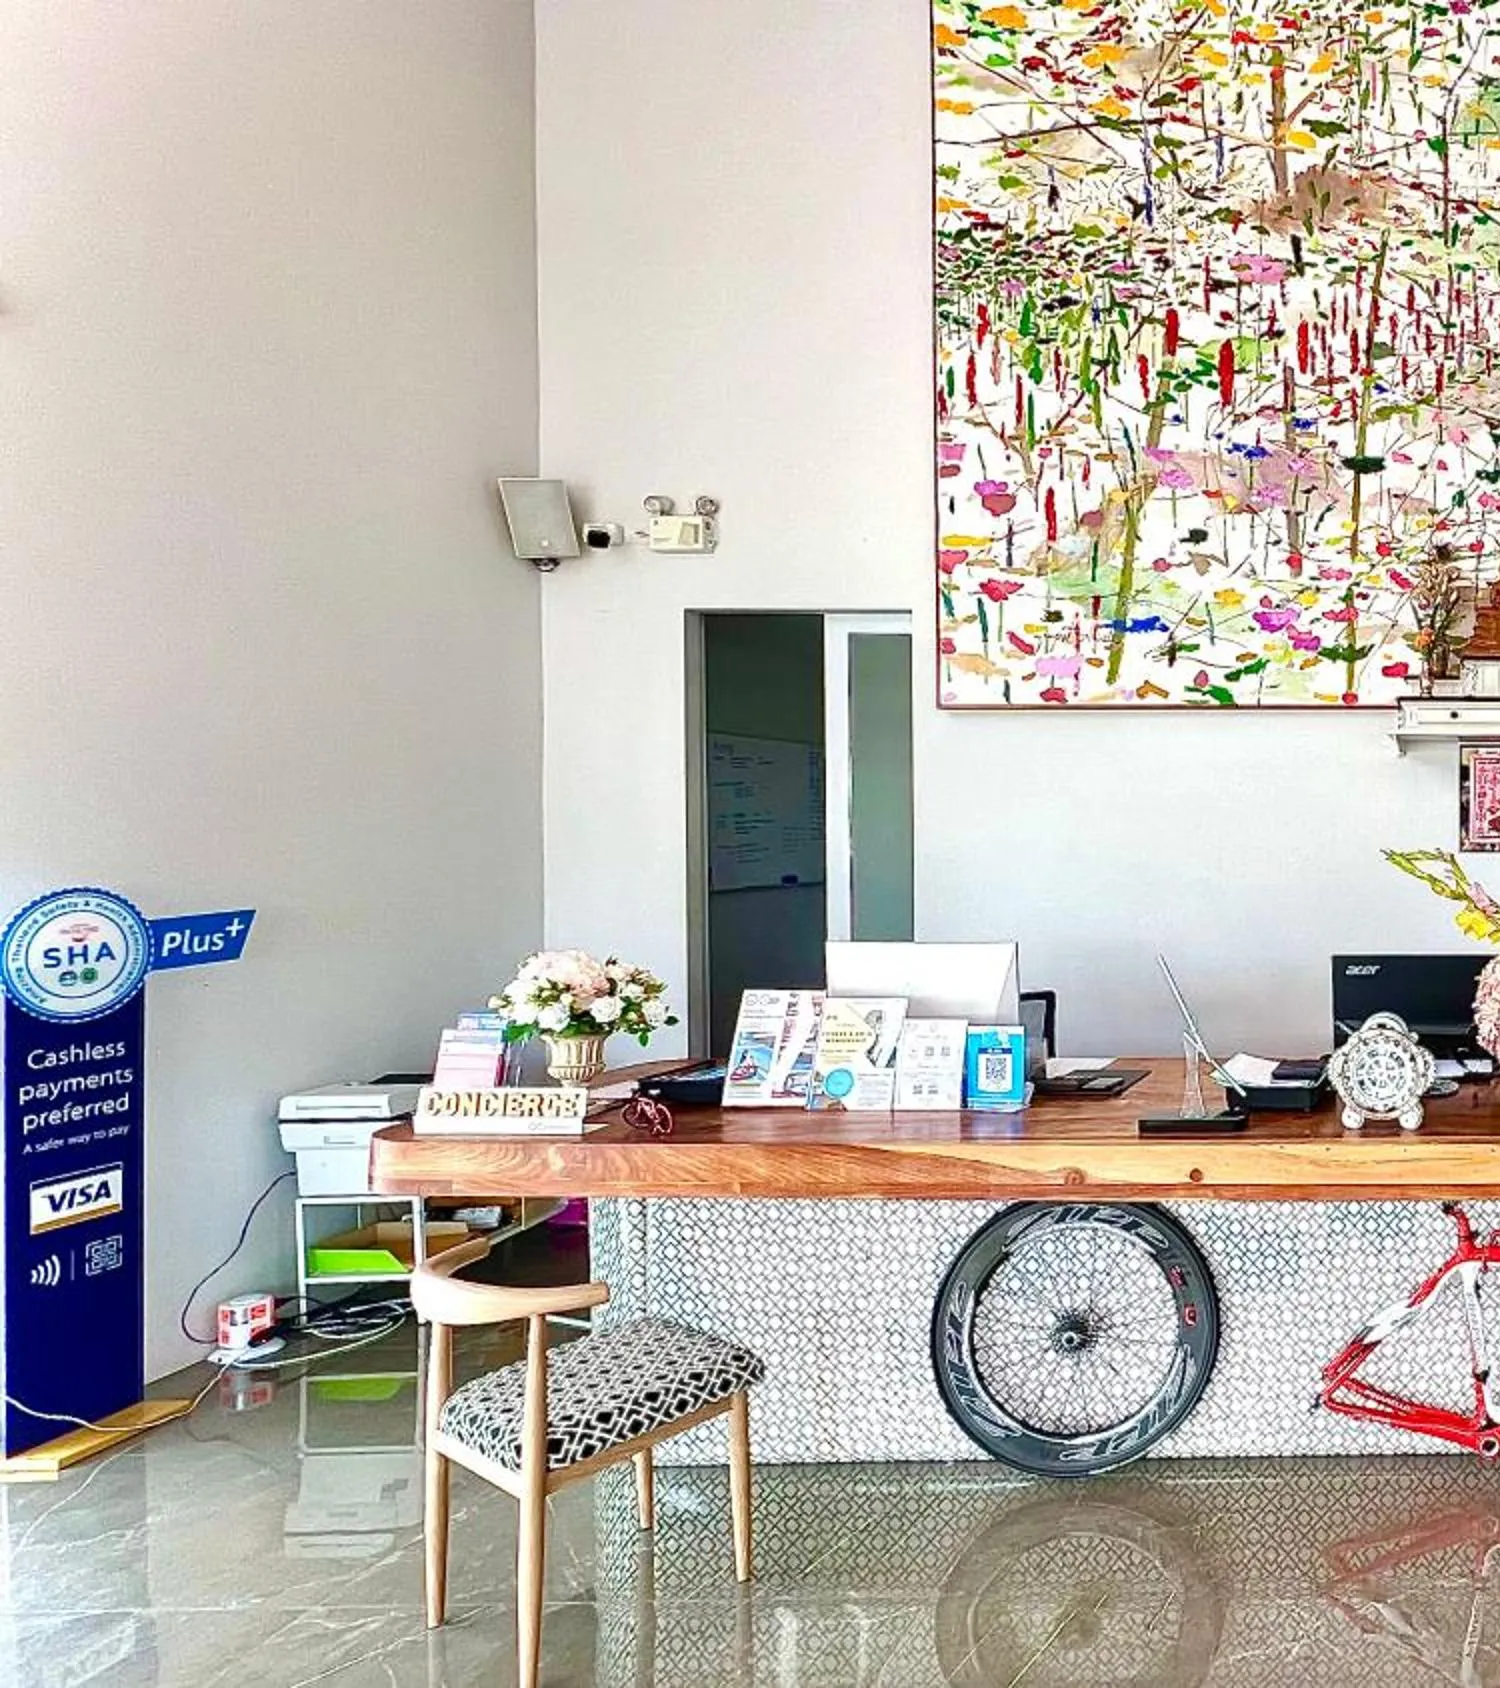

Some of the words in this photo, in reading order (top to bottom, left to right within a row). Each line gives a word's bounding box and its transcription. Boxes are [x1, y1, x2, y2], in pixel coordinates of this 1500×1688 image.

[43, 941, 116, 969] SHA
[1345, 965, 1381, 976] acer
[27, 1042, 126, 1070] Cashless
[19, 1068, 134, 1106] payments
[23, 1092, 129, 1136] preferred
[427, 1092, 580, 1117] CONCIERGE
[22, 1143, 33, 1155] A
[35, 1137, 65, 1152] safer
[67, 1133, 91, 1145] way
[93, 1129, 107, 1139] to
[108, 1124, 130, 1138] pay
[41, 1179, 112, 1213] VISA
